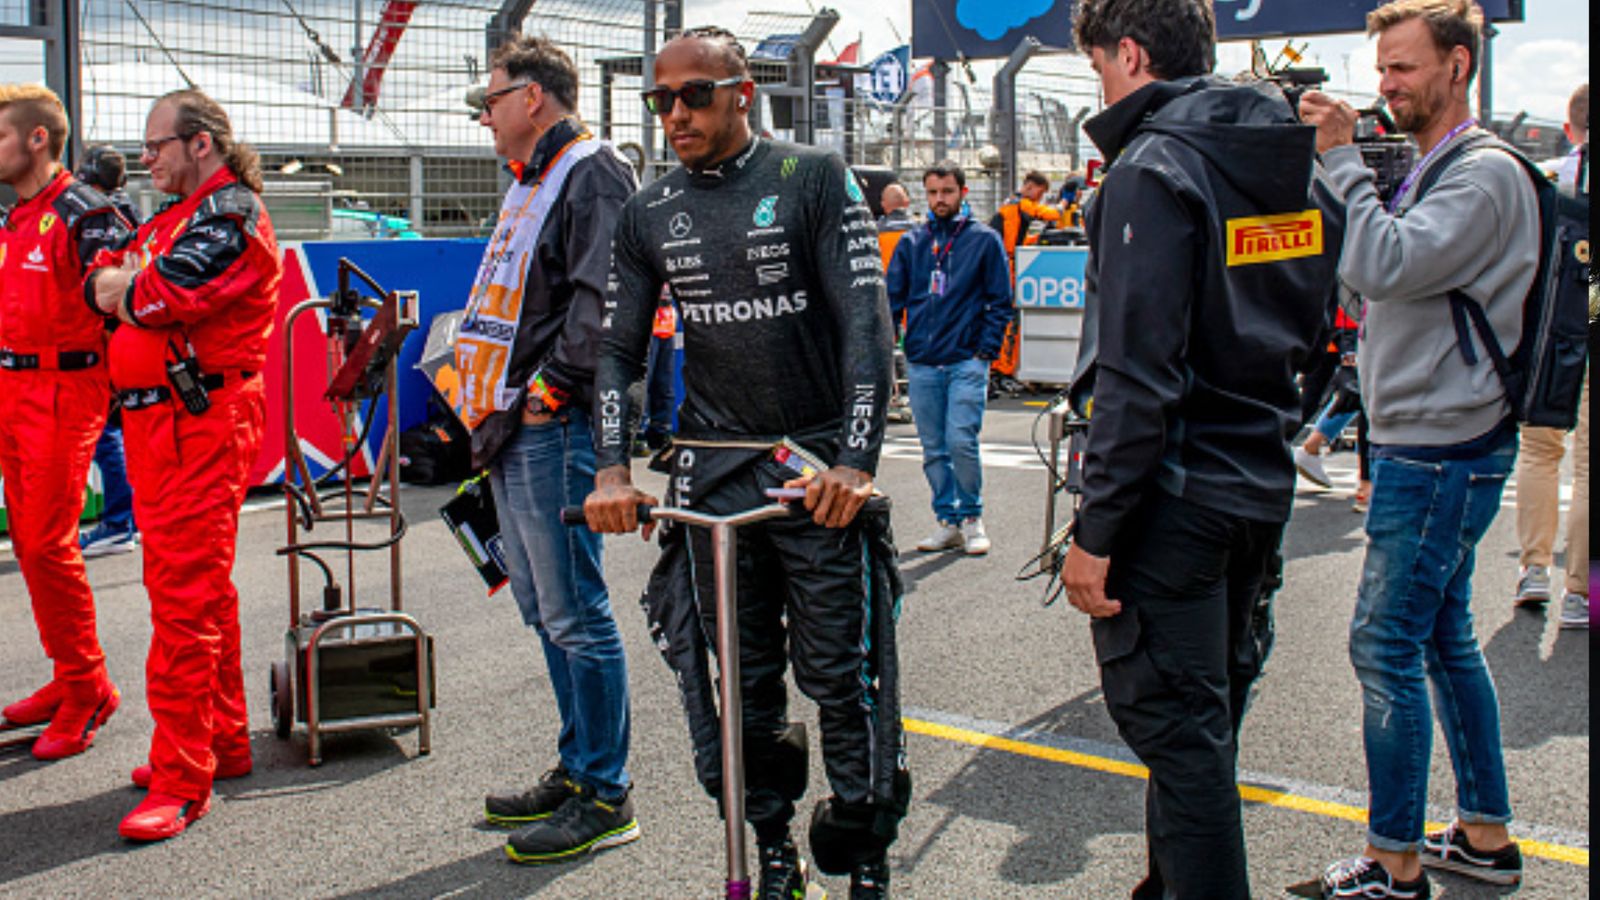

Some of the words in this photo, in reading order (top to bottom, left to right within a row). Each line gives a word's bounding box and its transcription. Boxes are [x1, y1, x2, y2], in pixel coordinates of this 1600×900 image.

[747, 244, 790, 261] INEOS
[1235, 221, 1313, 256] PIRELLI
[681, 291, 808, 324] PETRONAS
[599, 389, 620, 448] INEOS
[848, 384, 874, 450] INEOS
